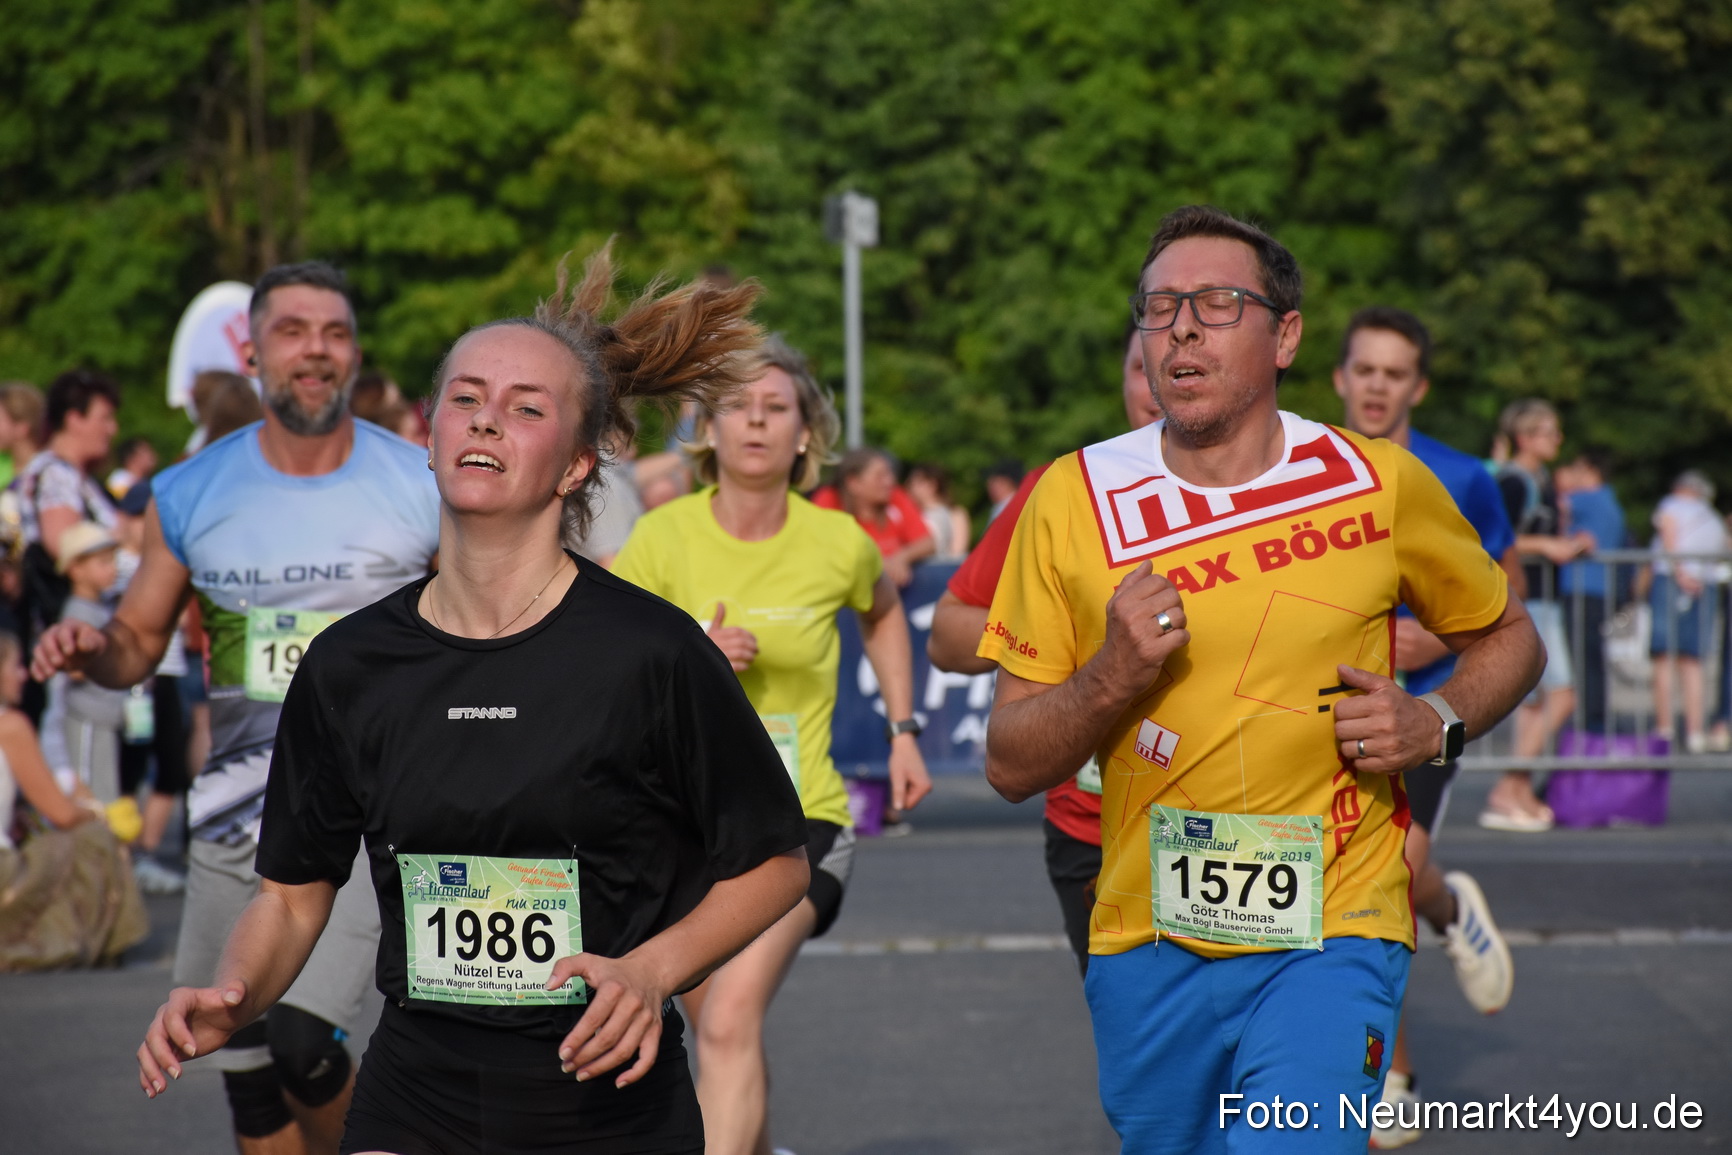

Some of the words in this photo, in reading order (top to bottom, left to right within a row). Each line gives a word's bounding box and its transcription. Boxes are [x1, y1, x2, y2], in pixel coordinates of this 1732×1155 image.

[1113, 551, 1240, 595] AX
[1252, 511, 1391, 573] BÖGL
[447, 706, 517, 720] STANNO
[1173, 832, 1239, 852] firmenlauf
[1254, 850, 1275, 862] run
[1280, 851, 1312, 862] 2019
[428, 881, 491, 900] firmenlauf
[1171, 855, 1298, 910] 1579
[505, 898, 527, 911] run
[532, 898, 567, 911] 2019
[1190, 903, 1219, 919] Götz
[1222, 908, 1276, 924] Thomas
[1175, 913, 1191, 924] Max
[1193, 916, 1212, 929] Bögl
[1214, 920, 1262, 934] Bauservice
[1264, 925, 1293, 935] GmbH
[427, 907, 556, 963] 1986
[454, 964, 493, 979] Nützel
[497, 966, 523, 979] Eva
[416, 975, 444, 987] Regens
[446, 978, 475, 990] Wagner
[477, 980, 512, 992] Stiftung
[515, 980, 573, 991] Lauteren
